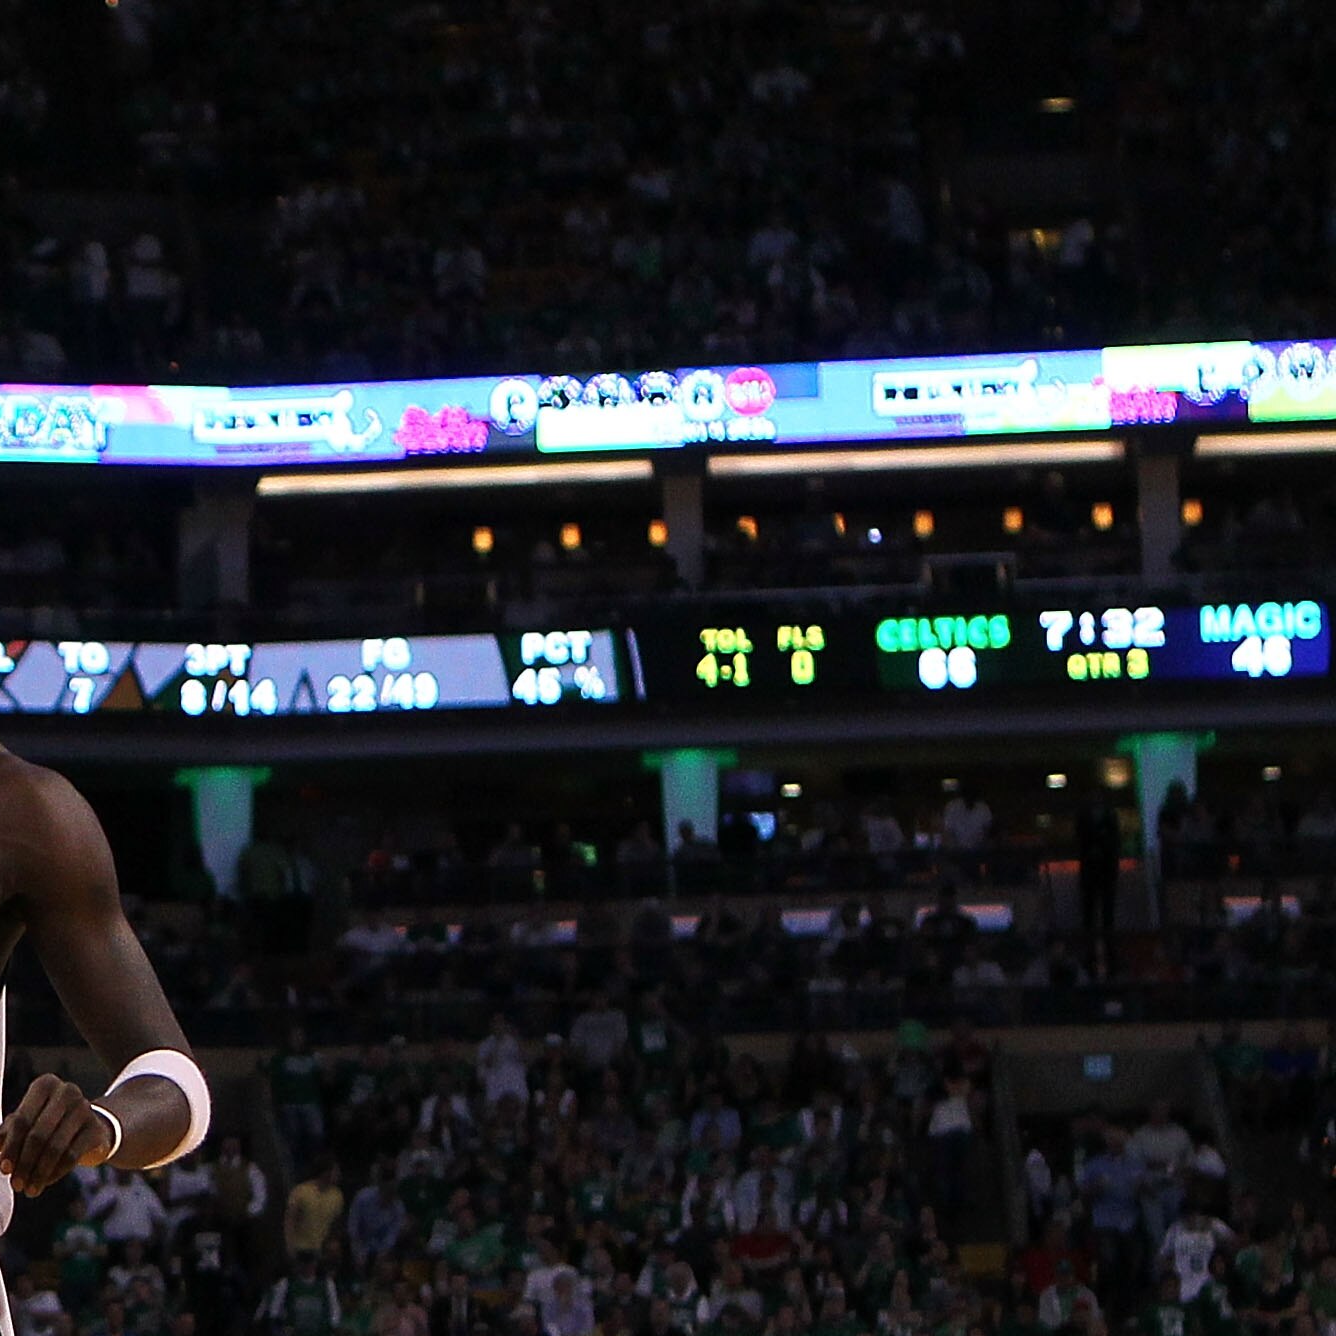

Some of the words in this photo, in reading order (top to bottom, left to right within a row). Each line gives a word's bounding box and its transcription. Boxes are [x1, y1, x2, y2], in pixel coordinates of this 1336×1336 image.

[700, 627, 753, 653] TOL
[777, 625, 824, 651] FLS
[877, 615, 1010, 652] CELTICS
[1039, 607, 1165, 651] 7:32
[1200, 600, 1321, 642] MAGIC
[58, 641, 109, 675] TO
[185, 644, 251, 677] 3PT
[362, 637, 411, 672] FG
[521, 630, 592, 665] PCT
[69, 677, 95, 714] 7
